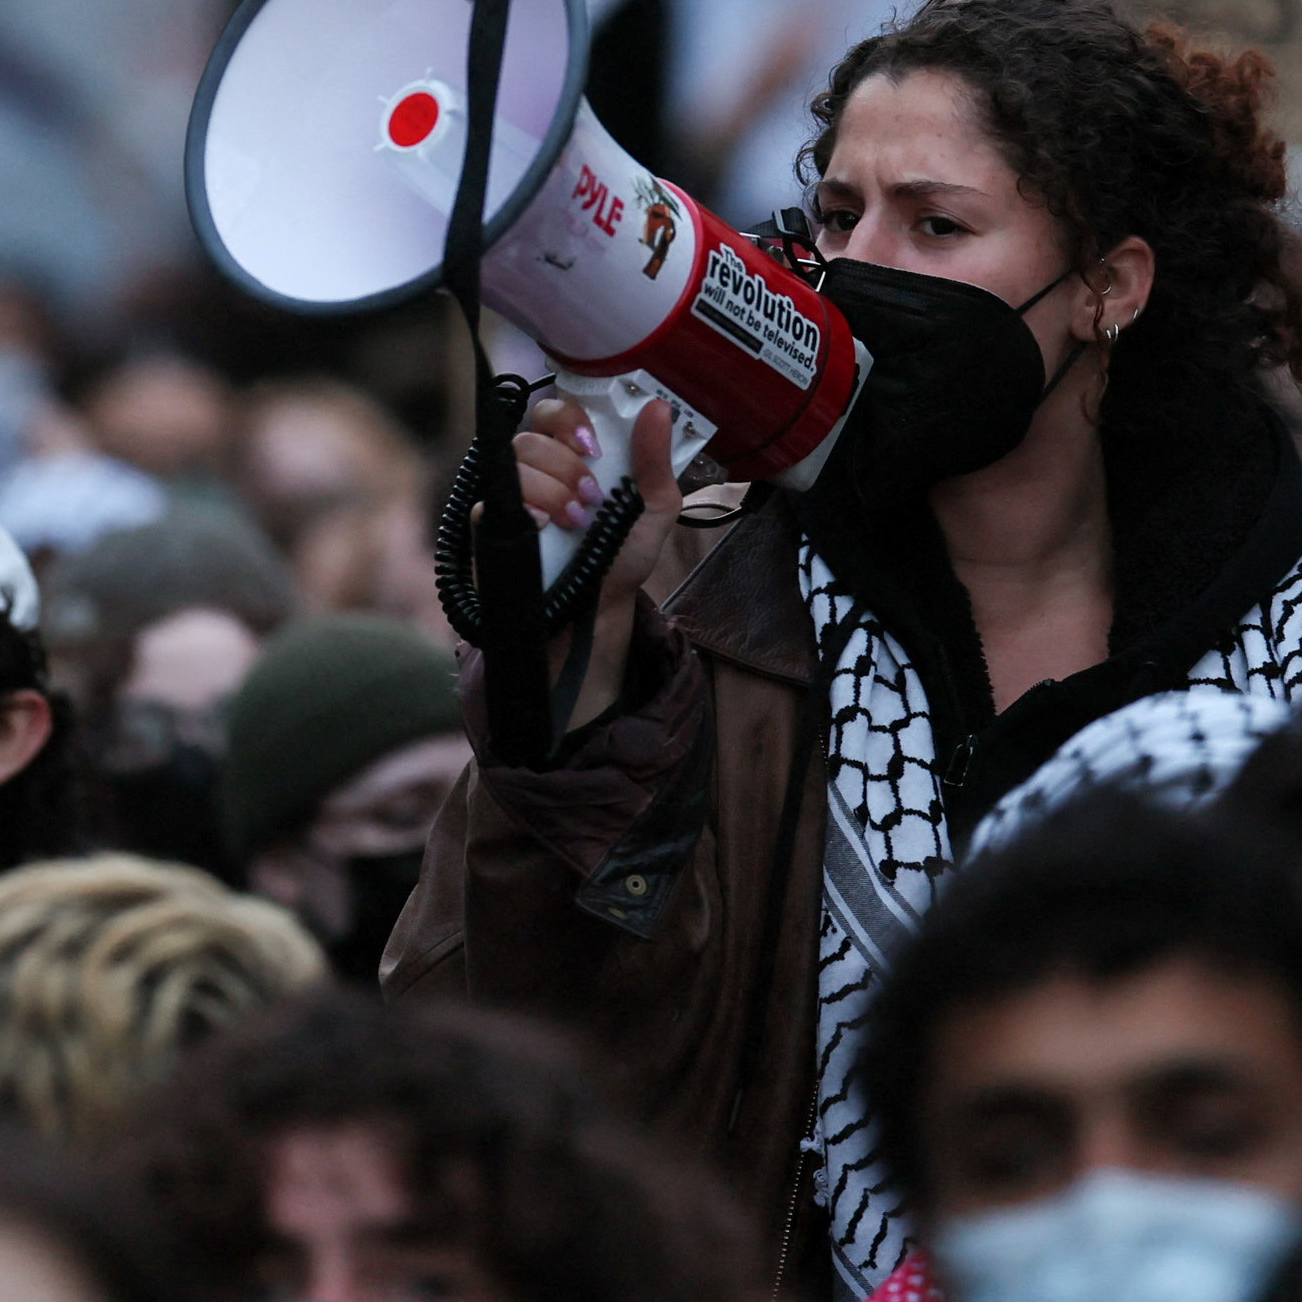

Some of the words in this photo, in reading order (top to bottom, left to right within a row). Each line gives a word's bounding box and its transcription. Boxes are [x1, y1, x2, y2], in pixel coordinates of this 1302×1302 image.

[571, 163, 625, 238] PYLE
[723, 248, 743, 273] The
[704, 282, 726, 306] will
[725, 299, 746, 321] not
[746, 309, 762, 332] be
[763, 324, 815, 372] televised.
[709, 255, 818, 353] revolution
